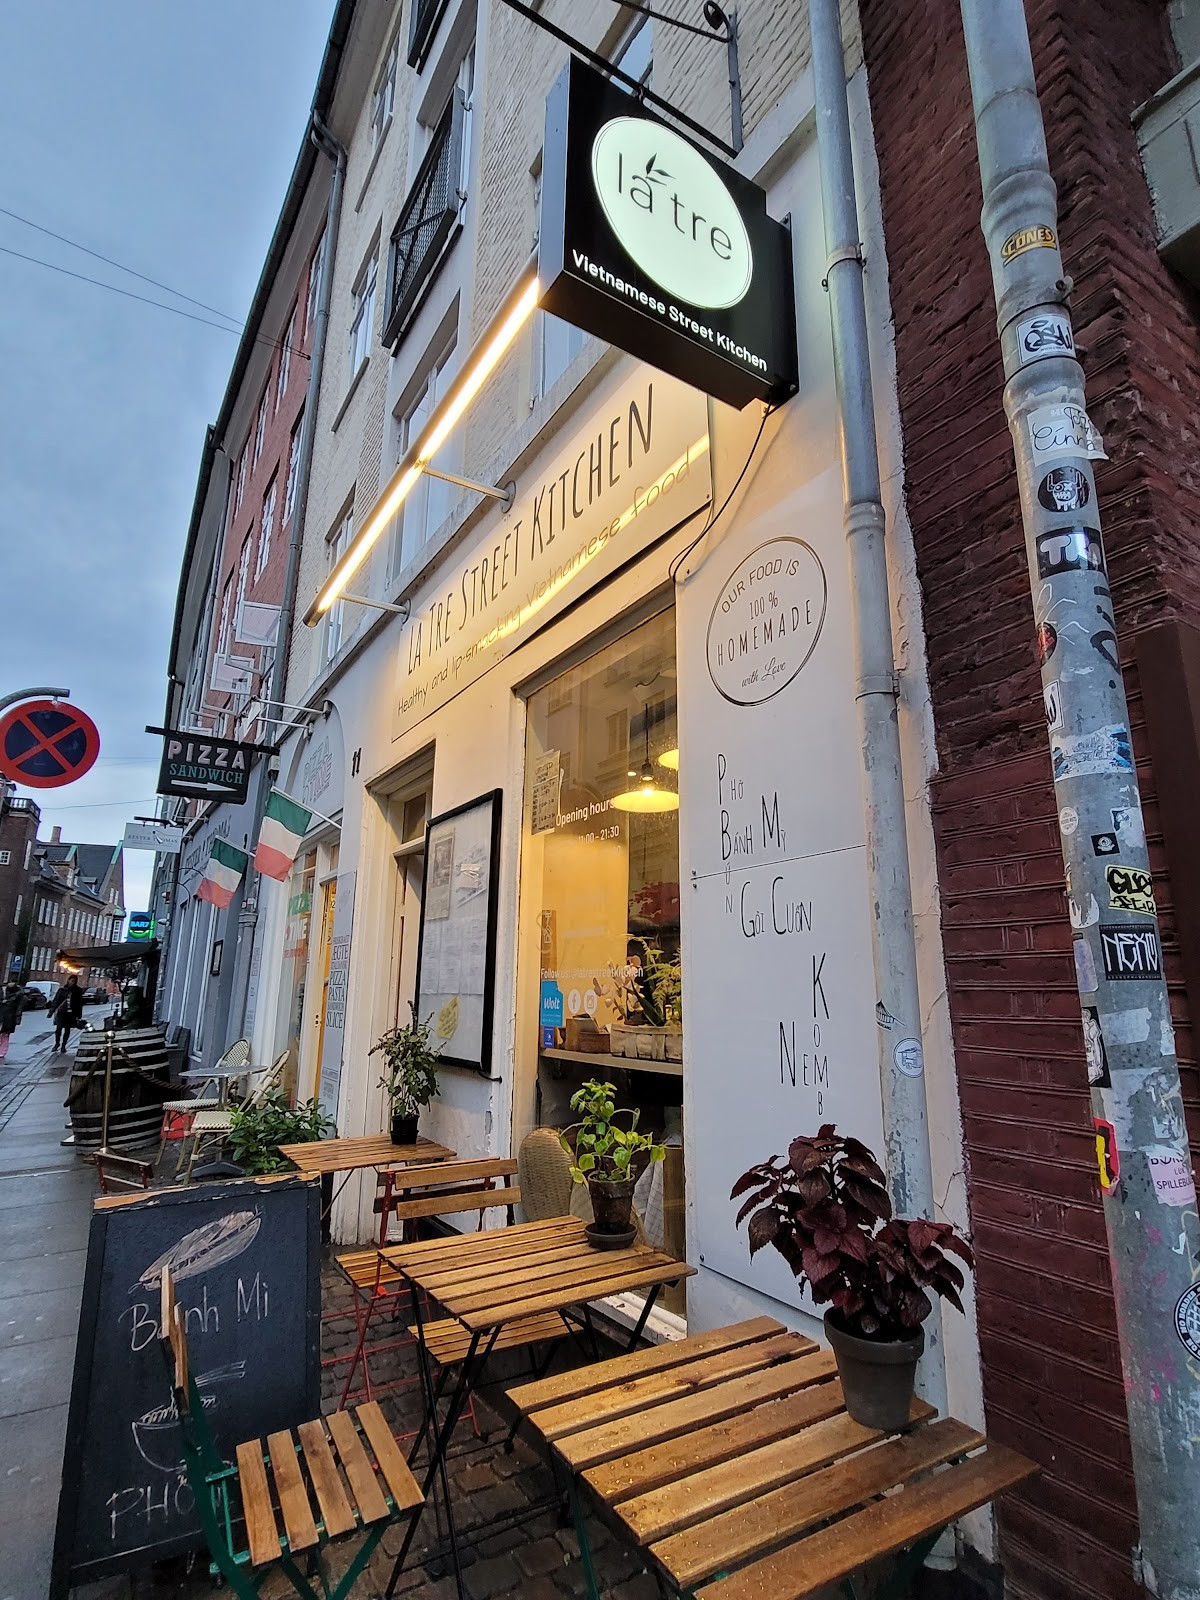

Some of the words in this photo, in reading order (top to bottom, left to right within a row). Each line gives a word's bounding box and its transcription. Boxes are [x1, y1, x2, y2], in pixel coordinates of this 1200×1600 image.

[670, 192, 732, 260] tre
[573, 249, 666, 314] Vietnamese
[669, 305, 714, 342] Street
[716, 332, 768, 372] Kitchen
[408, 622, 422, 676] LA
[429, 593, 453, 657] TRE
[459, 520, 522, 631] STREET
[531, 383, 653, 561] KITCHEN
[721, 581, 746, 614] OUR
[749, 558, 783, 586] FOOD
[785, 558, 800, 576] IS
[749, 597, 765, 620] 100
[768, 590, 778, 609] %
[717, 599, 812, 667] HOMEMADE
[398, 682, 429, 717] Healthy
[432, 658, 449, 690] and
[741, 670, 759, 688] with
[761, 656, 786, 680] Love
[167, 740, 246, 770] PIZZA
[169, 763, 244, 785] SANDWICH
[555, 807, 589, 829] Opening
[589, 797, 615, 816] hours
[600, 825, 620, 841] 21:30
[329, 970, 346, 986] PIZZA
[541, 968, 561, 979] Follow
[327, 986, 345, 1002] PASTA
[544, 997, 560, 1010] Wolt
[326, 1011, 343, 1029] SLICE
[118, 1285, 219, 1351] Bnh
